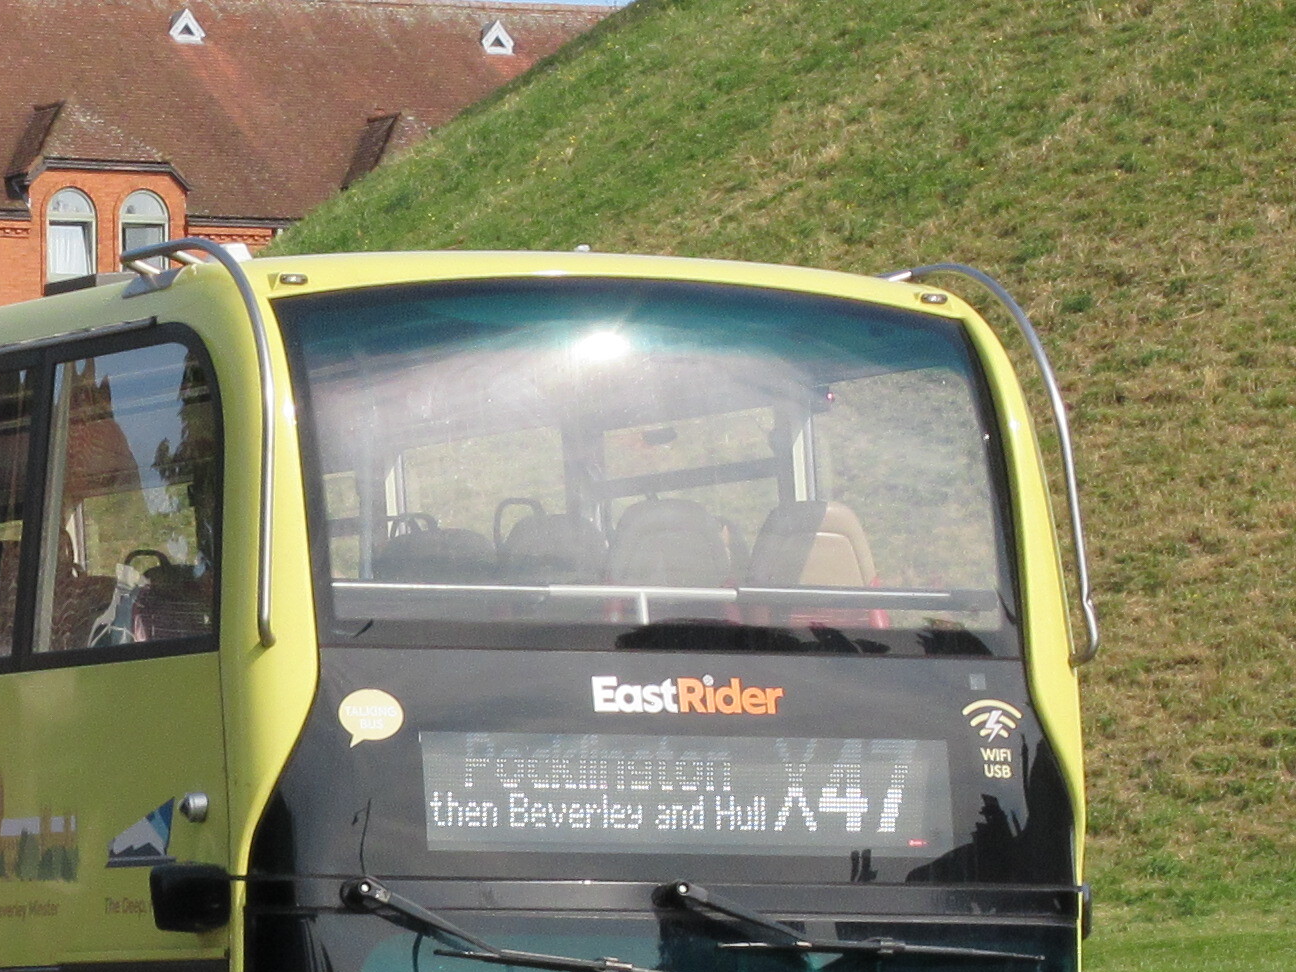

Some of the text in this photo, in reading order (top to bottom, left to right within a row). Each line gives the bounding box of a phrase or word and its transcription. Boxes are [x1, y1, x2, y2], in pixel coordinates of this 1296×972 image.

[591, 674, 784, 715] EastRider
[345, 706, 398, 717] TALKING
[360, 719, 384, 729] BUS
[980, 747, 1012, 762] WIFI
[984, 764, 1012, 778] USB
[773, 738, 917, 832] X47
[430, 791, 766, 831] then Beverley and Hull
